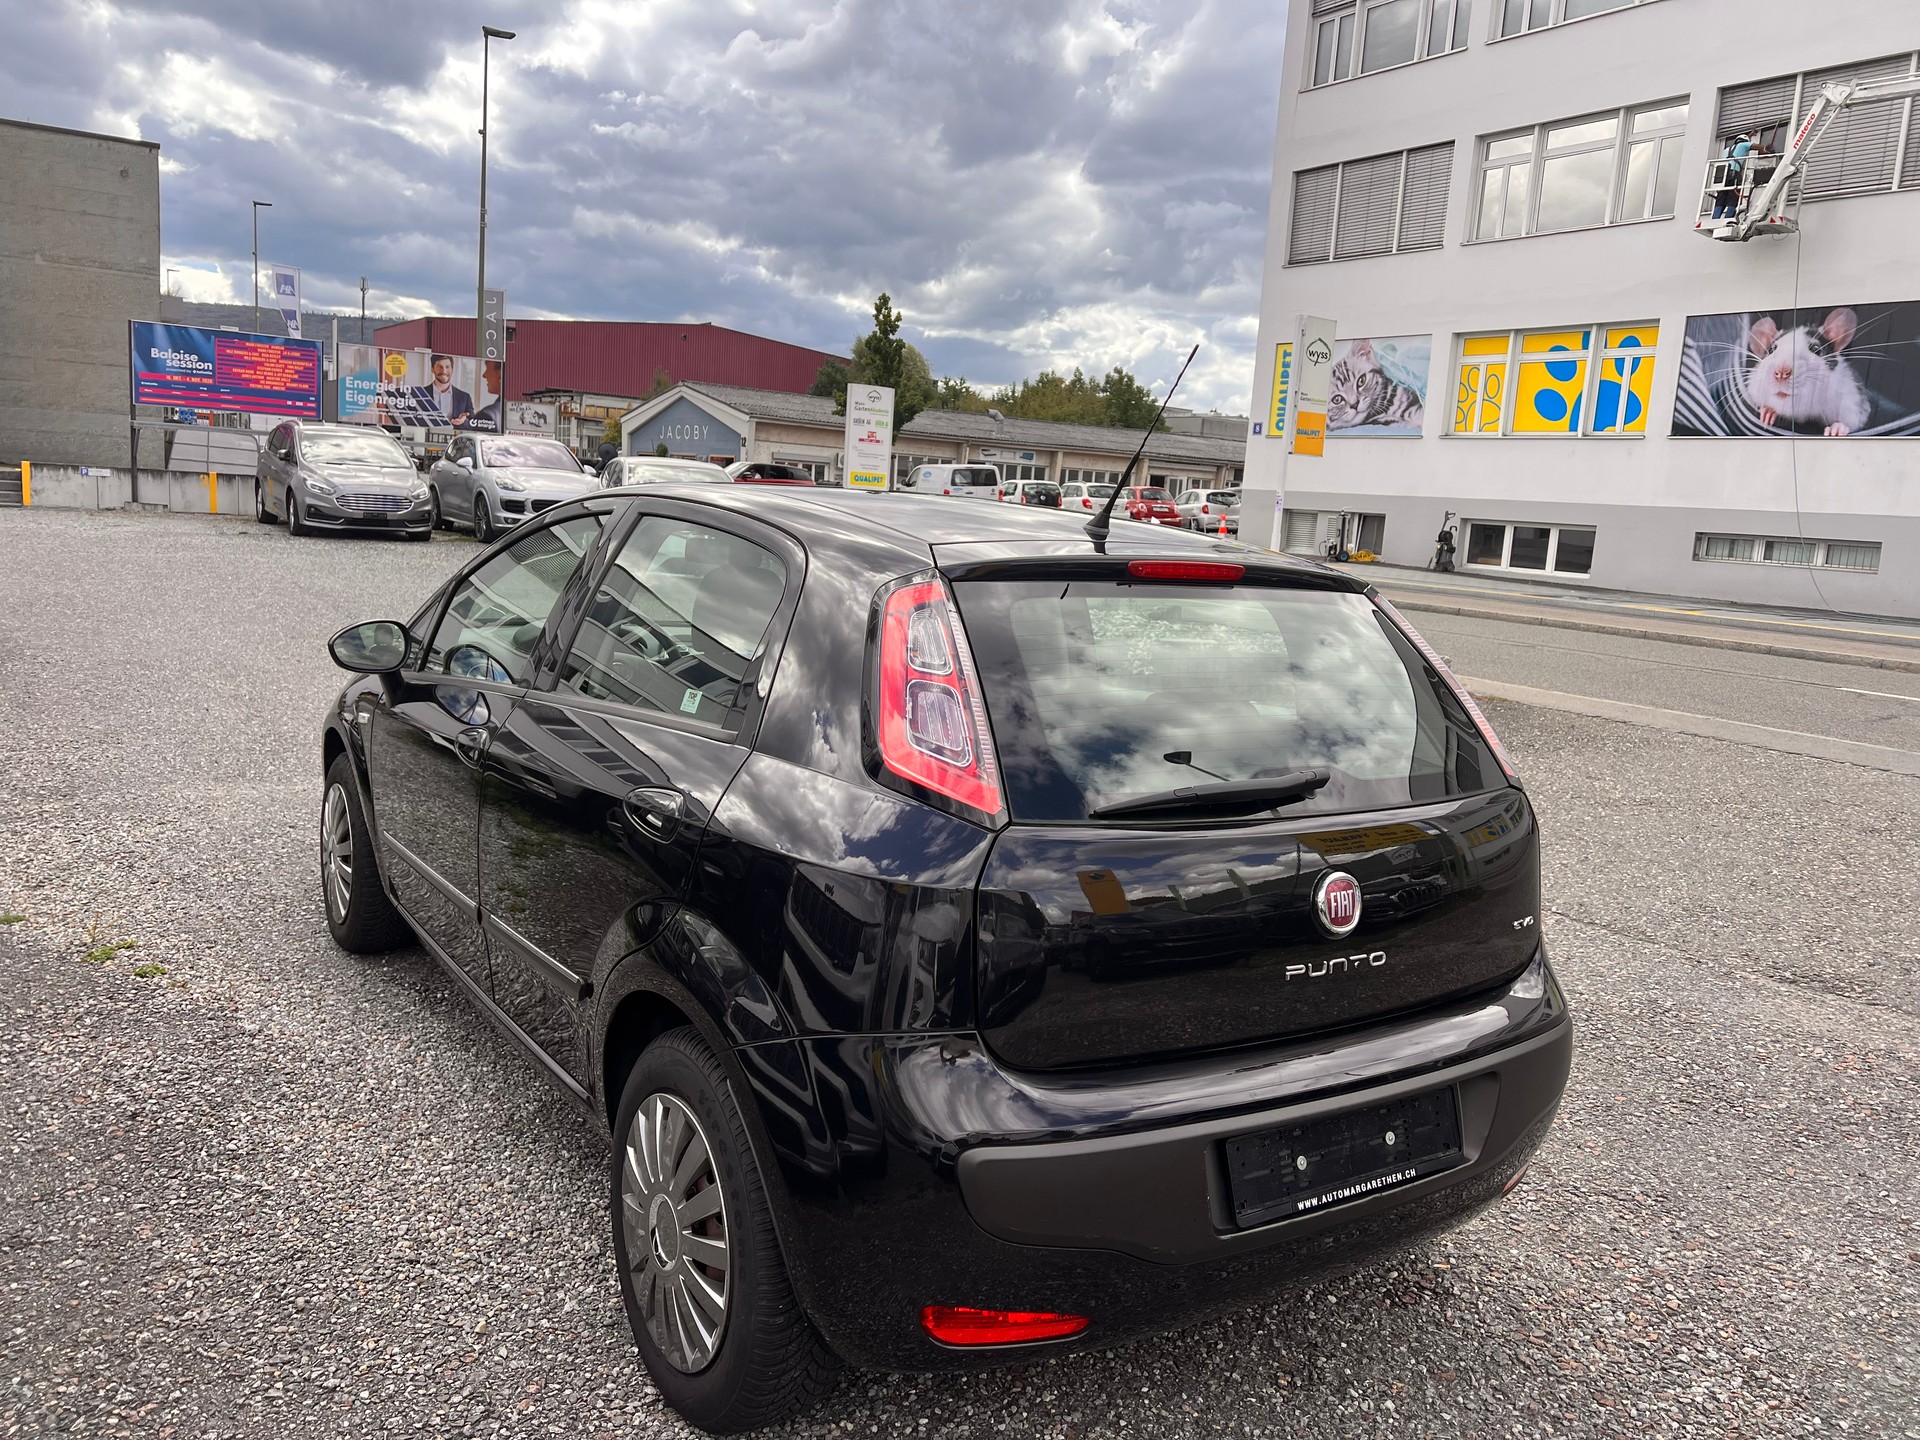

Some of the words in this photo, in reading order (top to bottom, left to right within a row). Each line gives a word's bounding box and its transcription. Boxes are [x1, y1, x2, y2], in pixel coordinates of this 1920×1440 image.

[1793, 114, 1815, 149] mateco
[150, 348, 198, 361] Baloise
[1308, 350, 1328, 366] wyss
[166, 359, 212, 370] session
[346, 376, 395, 393] Energie
[400, 382, 411, 393] in
[1275, 350, 1292, 430] QUALIPET
[346, 390, 417, 408] Eigenregie
[660, 425, 708, 439] JACOBY
[1255, 424, 1260, 433] 8
[1296, 428, 1320, 436] QUALIPET
[1330, 889, 1354, 918] FIAT
[1285, 951, 1387, 981] PUNTO
[1297, 1168, 1416, 1210] WWW.AUTOMARGARETHEN.CH
